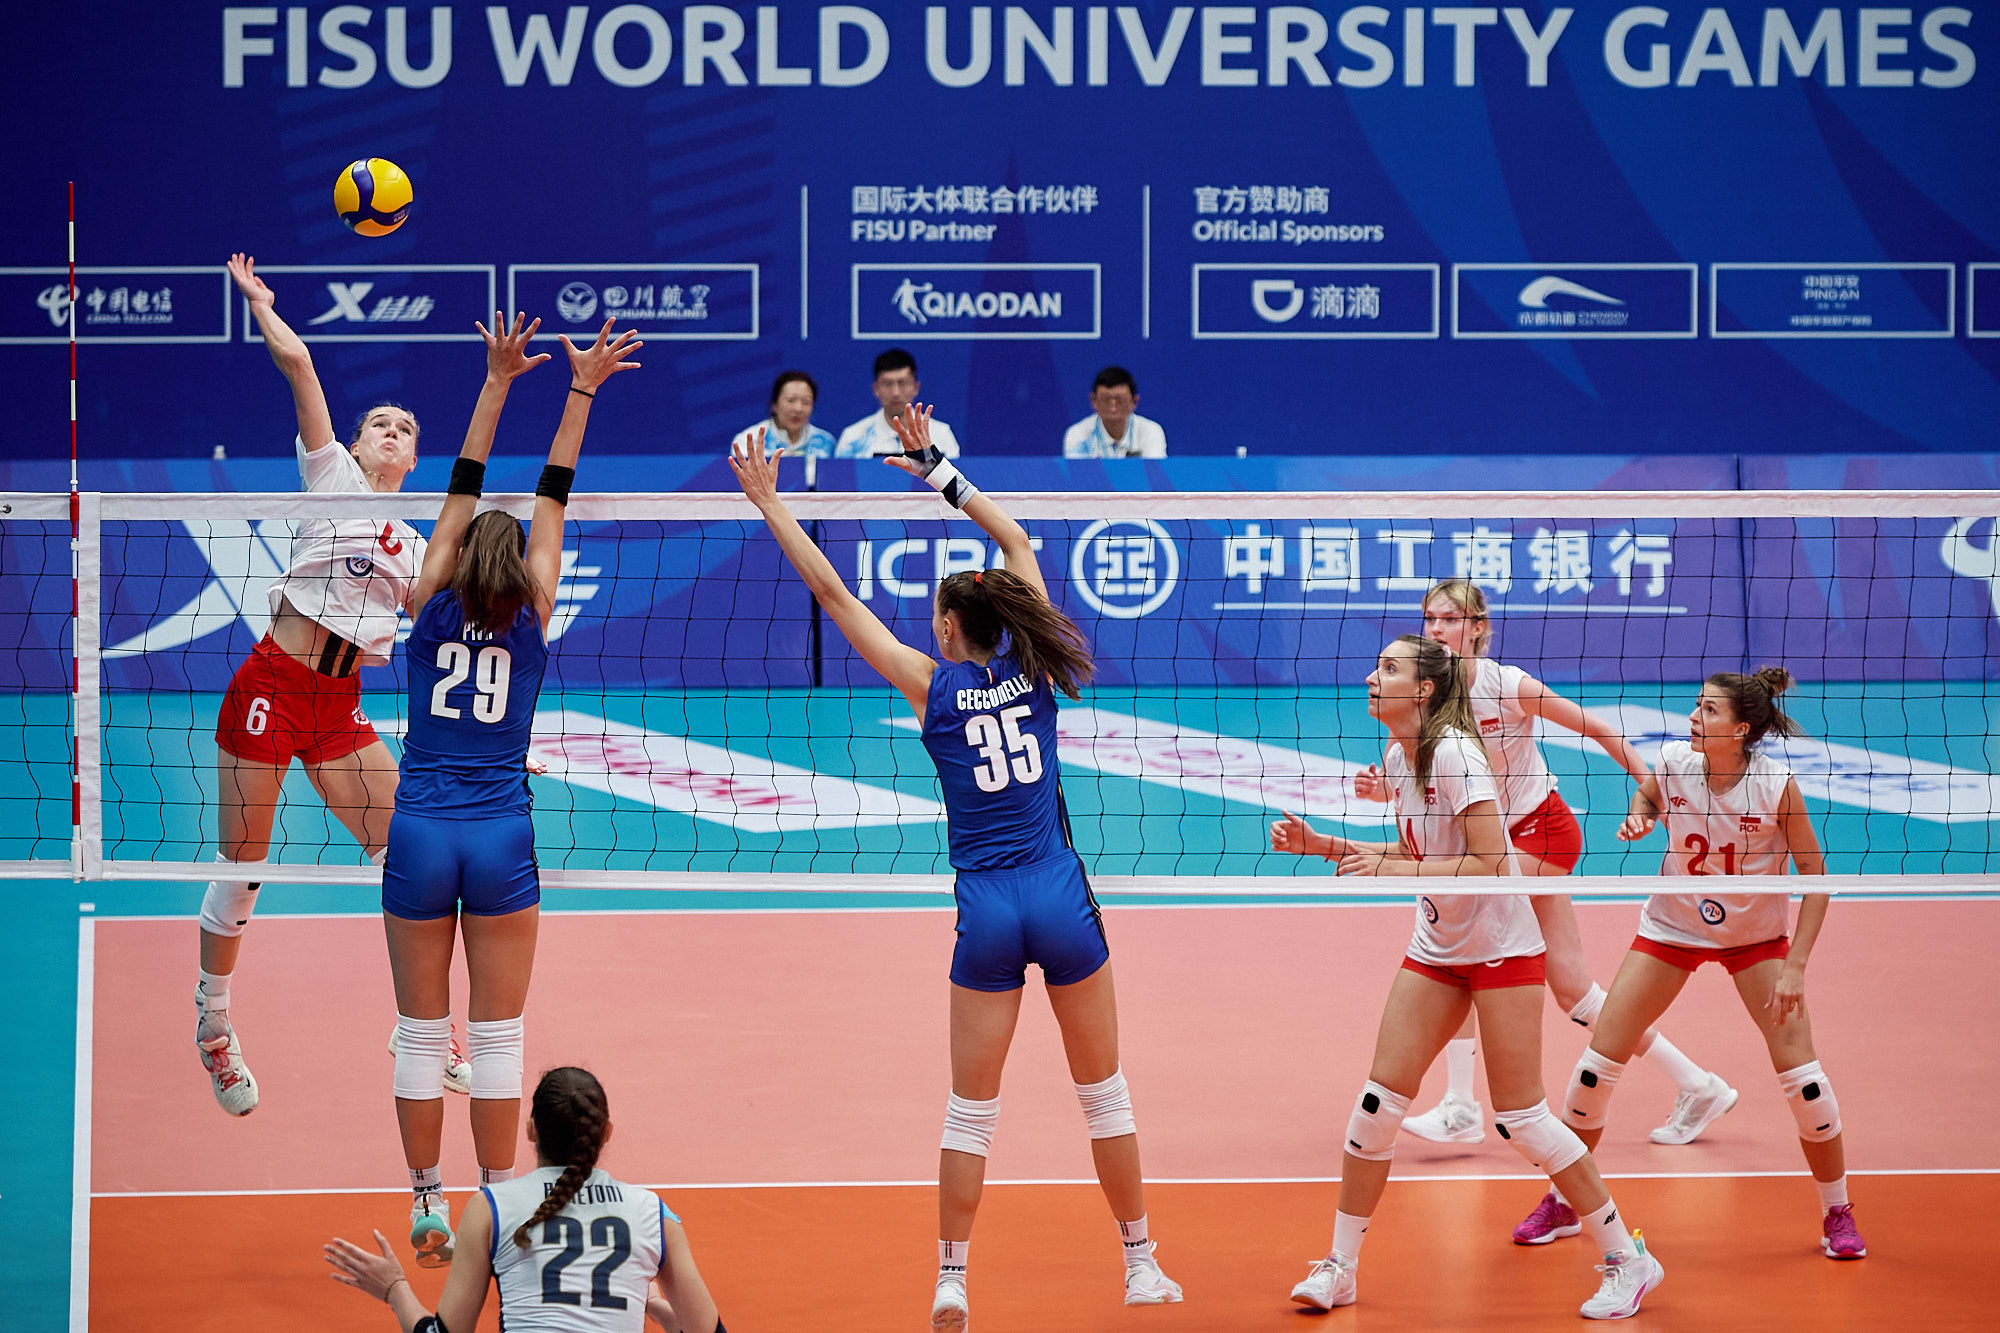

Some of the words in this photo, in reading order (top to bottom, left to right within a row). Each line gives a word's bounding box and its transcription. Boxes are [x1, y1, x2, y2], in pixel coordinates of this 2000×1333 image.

[224, 5, 452, 88] FISU
[487, 4, 890, 88] WORLD
[926, 5, 1574, 88] UNIVERSITY
[1604, 5, 1975, 88] GAMES
[851, 185, 1099, 214] 国际大体联合作伙伴
[1194, 185, 1330, 214] 官方赞助商
[852, 219, 906, 241] FISU
[909, 219, 997, 241] Partner
[1192, 219, 1278, 241] Official
[1281, 219, 1384, 245] Sponsors
[85, 287, 172, 313] 中国电信
[603, 284, 710, 309] 四川航空
[922, 292, 1062, 318] QIAODAN
[1311, 284, 1380, 319] 滴滴
[1839, 289, 1860, 300] AN
[856, 536, 1043, 601] ICB
[1222, 523, 1673, 598] 中国工商银行
[430, 641, 511, 724] 29
[246, 697, 271, 736] 6
[1481, 725, 1501, 735] POL
[964, 704, 1044, 793] 35
[1739, 824, 1760, 833] POL
[1684, 833, 1736, 875] 21
[1704, 905, 1720, 918] PZU
[543, 1182, 624, 1206] PETONI
[541, 1215, 632, 1311] 22
